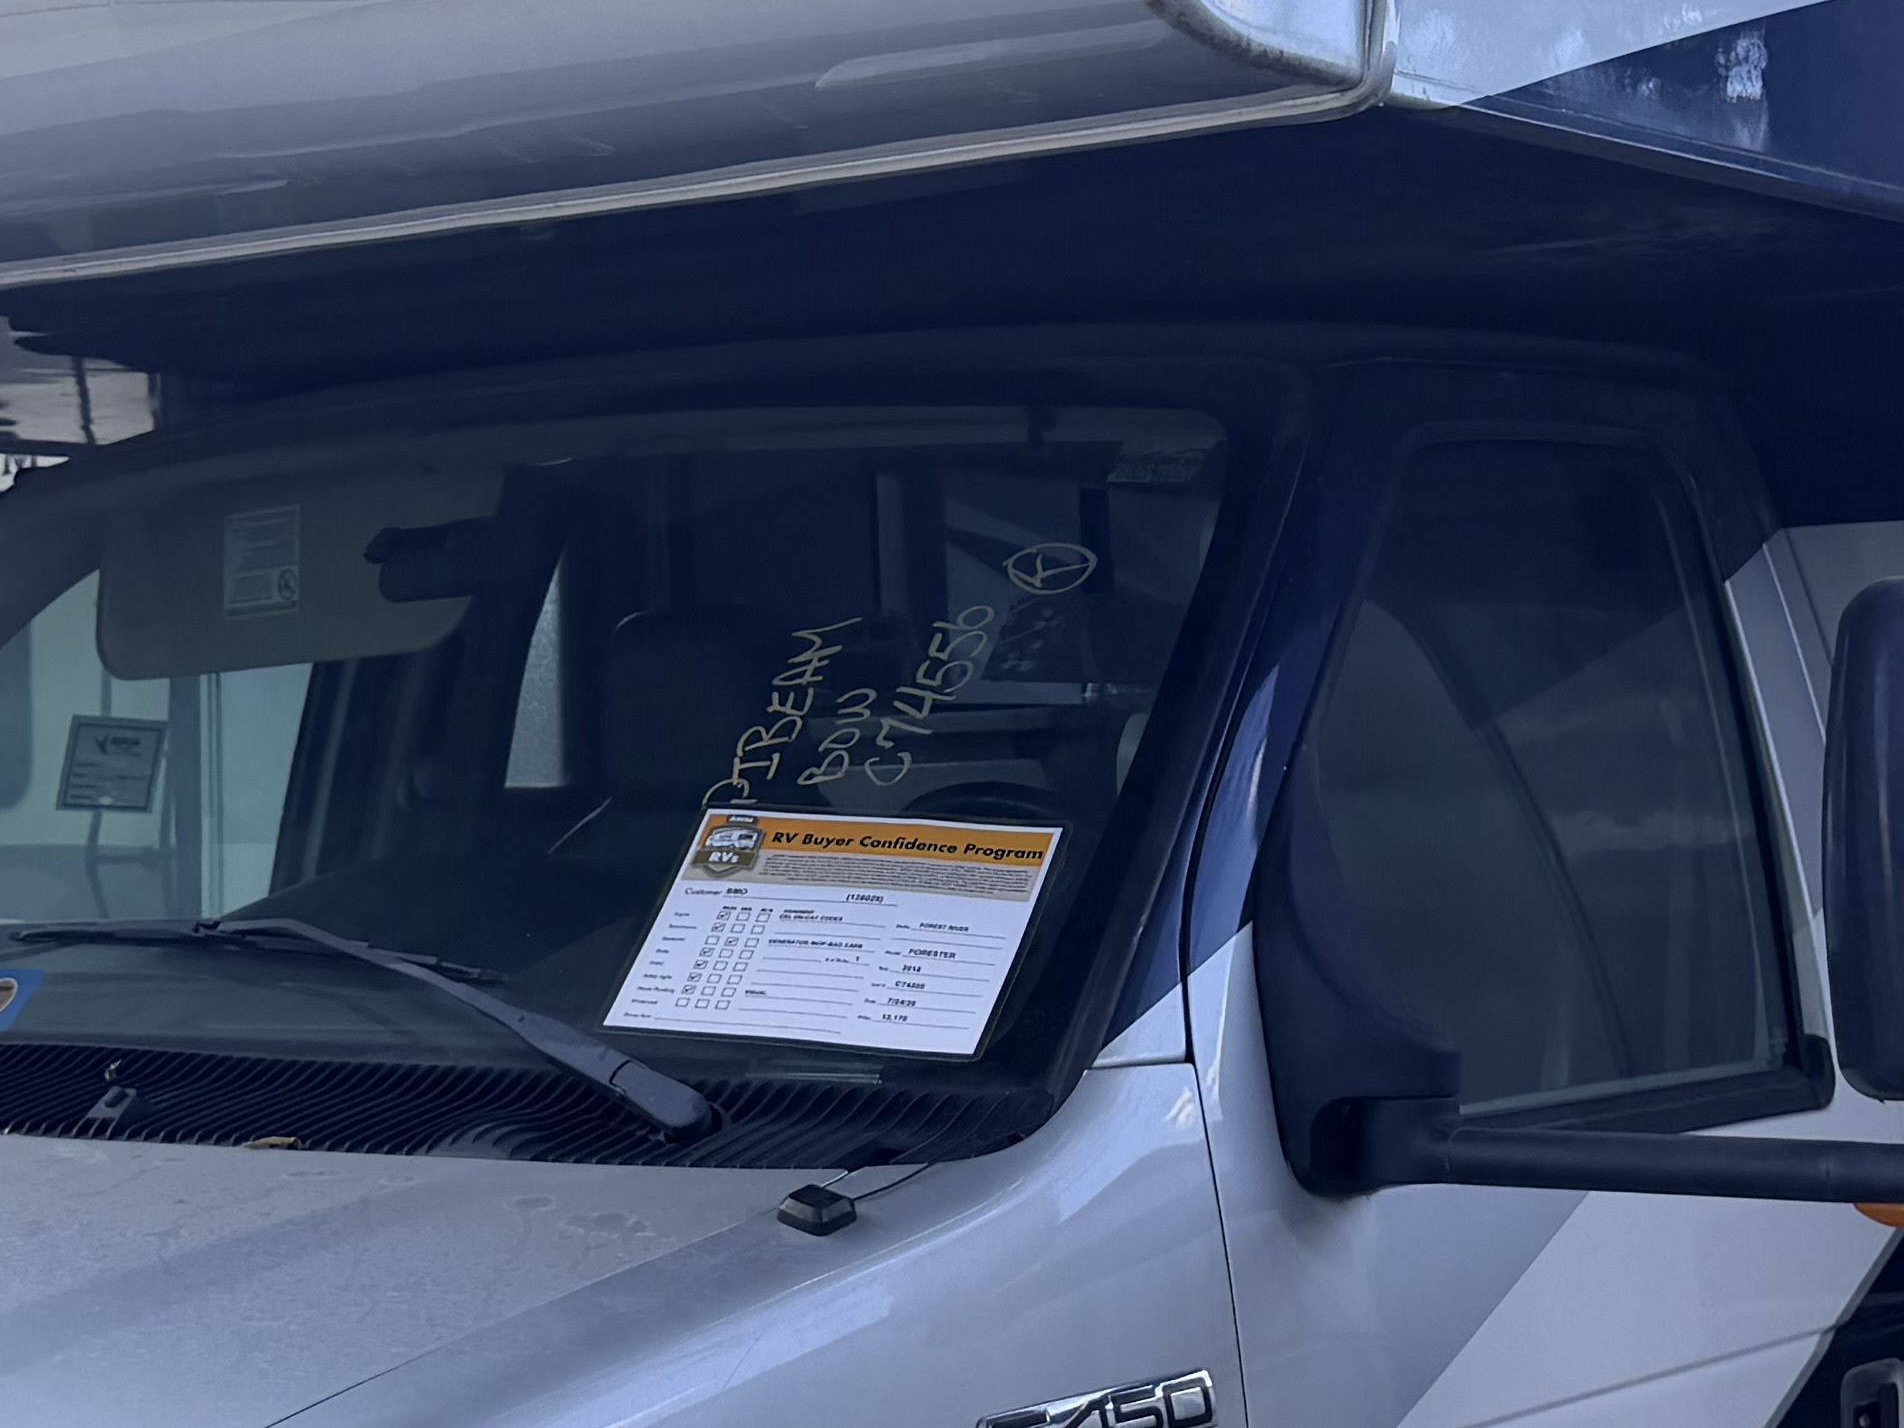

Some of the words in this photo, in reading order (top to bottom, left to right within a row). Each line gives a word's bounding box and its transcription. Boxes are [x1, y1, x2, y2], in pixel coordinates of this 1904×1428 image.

[771, 831, 798, 844] RV
[802, 833, 854, 849] Buyer
[859, 836, 958, 854] Confidence
[963, 843, 1043, 861] Program
[708, 851, 740, 864] RVs
